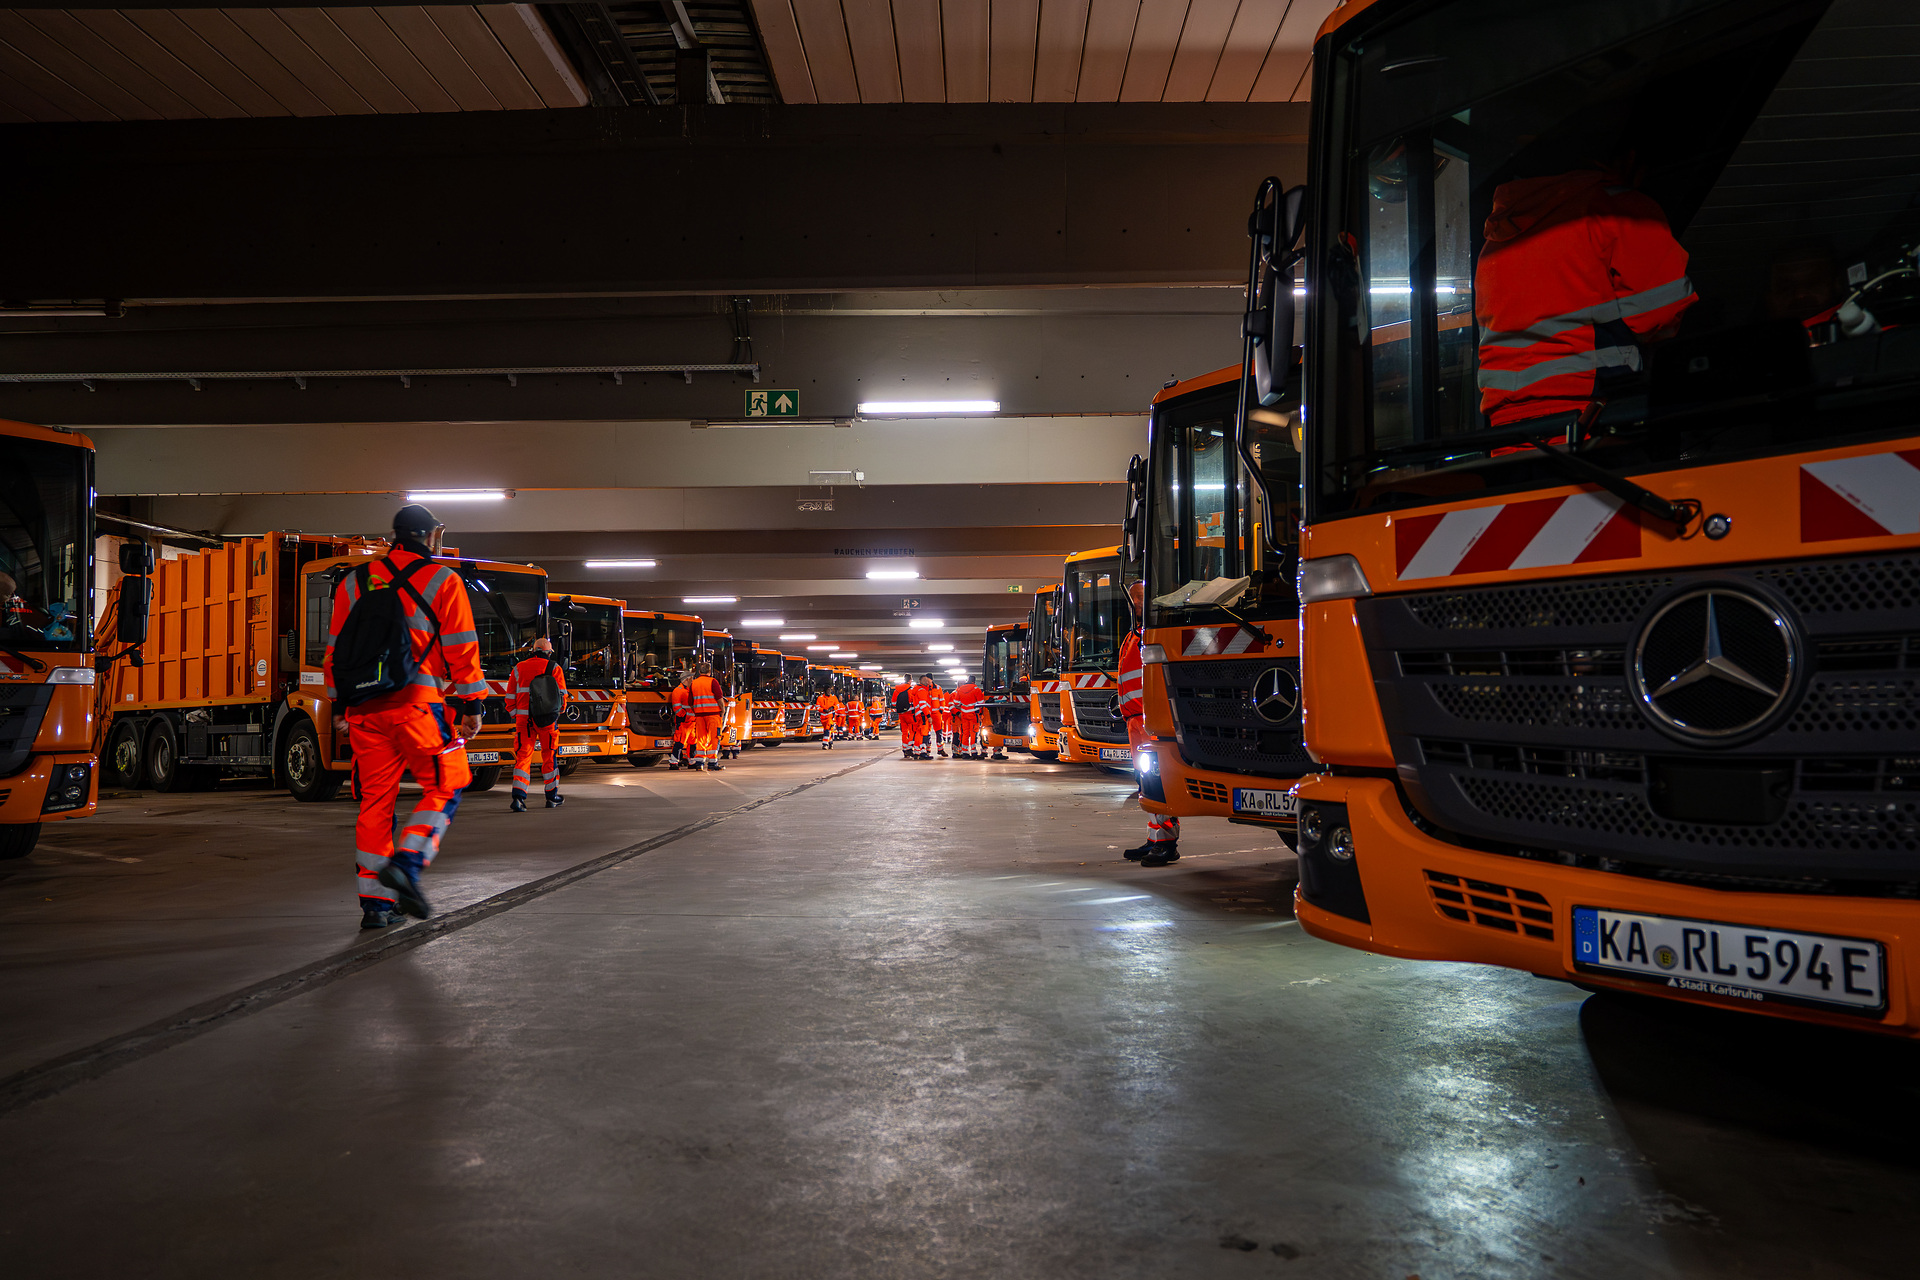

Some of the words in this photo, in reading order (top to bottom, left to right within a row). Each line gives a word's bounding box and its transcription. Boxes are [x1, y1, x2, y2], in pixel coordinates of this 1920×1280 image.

[834, 548, 871, 556] RAUCHEN
[483, 753, 498, 761] 1314
[1241, 792, 1256, 808] KA
[1265, 793, 1280, 809] RL
[1583, 941, 1592, 953] D
[1600, 918, 1649, 965] KA
[1682, 927, 1738, 976] RL
[1745, 935, 1874, 997] 594E
[1679, 979, 1708, 993] Stadt
[1710, 984, 1764, 1001] Karlsruhe
